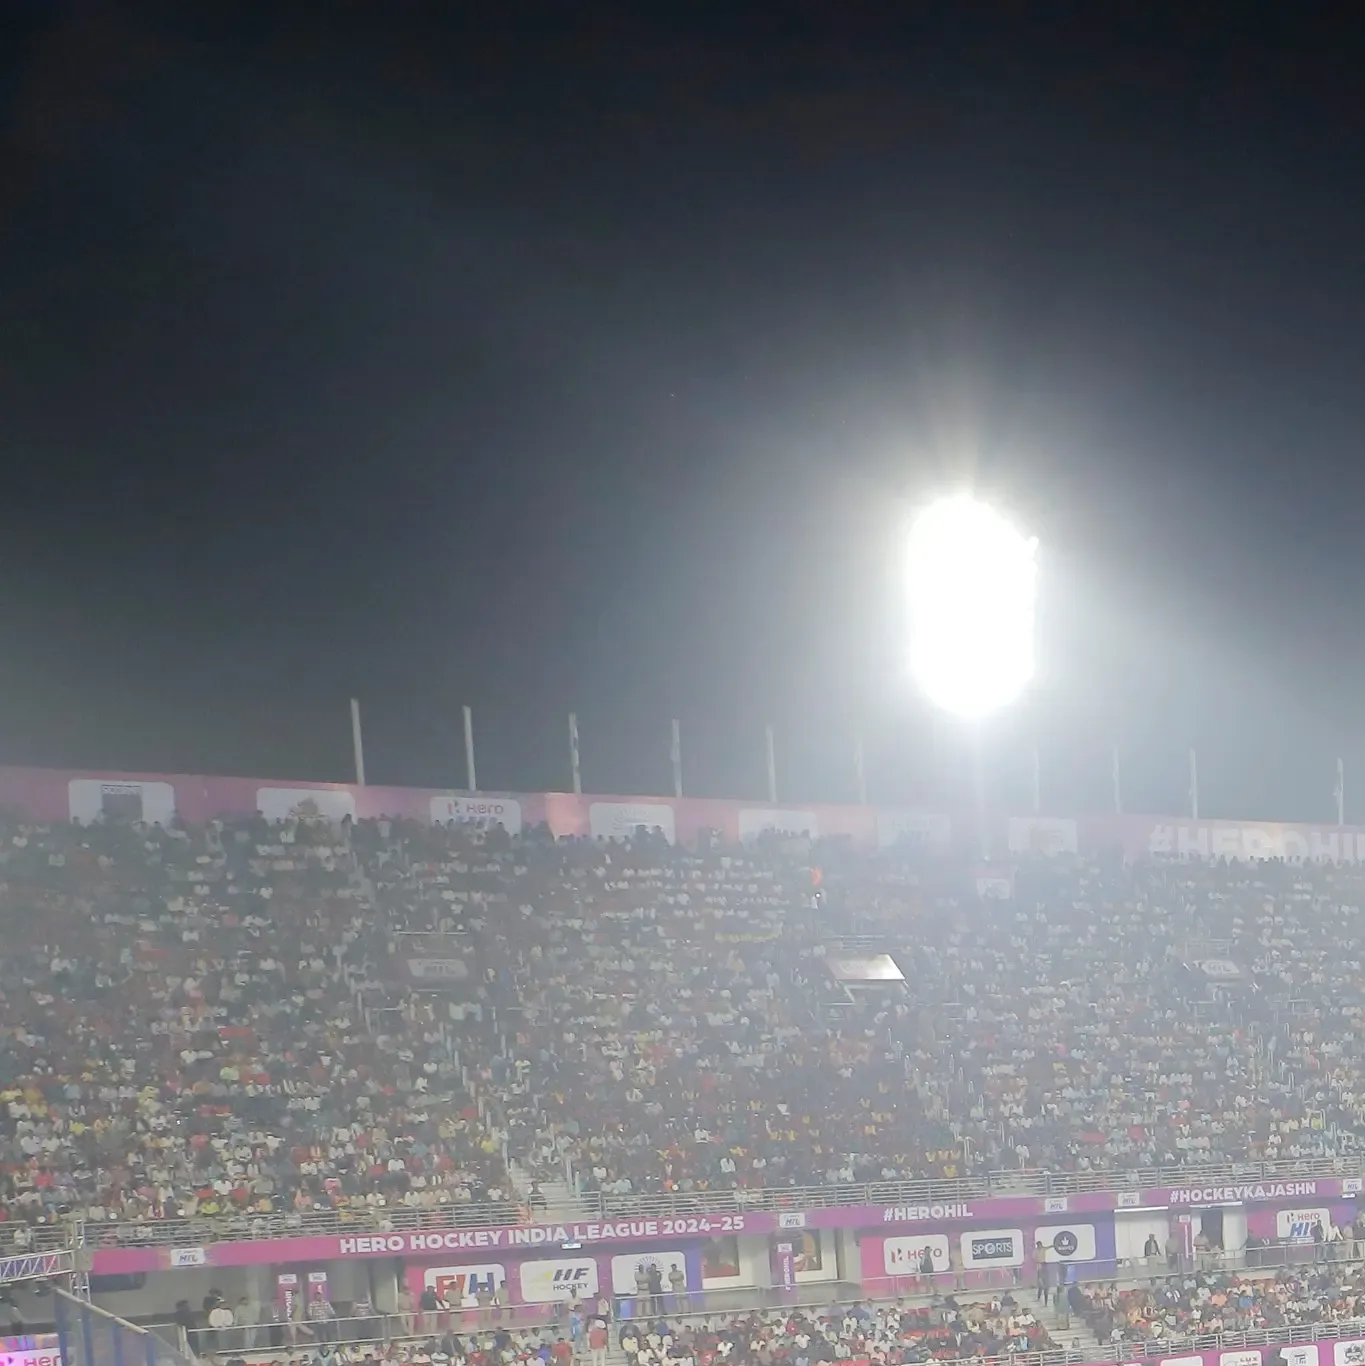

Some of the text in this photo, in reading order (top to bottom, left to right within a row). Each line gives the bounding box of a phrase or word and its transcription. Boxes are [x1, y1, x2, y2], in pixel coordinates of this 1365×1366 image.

[1170, 1181, 1316, 1203] #HOCKEYKAJASHN
[883, 1204, 973, 1221] #HEROHIL
[340, 1235, 404, 1254] HERO
[410, 1230, 502, 1250] HOCKEY
[507, 1224, 567, 1245] INDIA
[573, 1219, 658, 1241] LEAGUE
[907, 1248, 942, 1260] Heo
